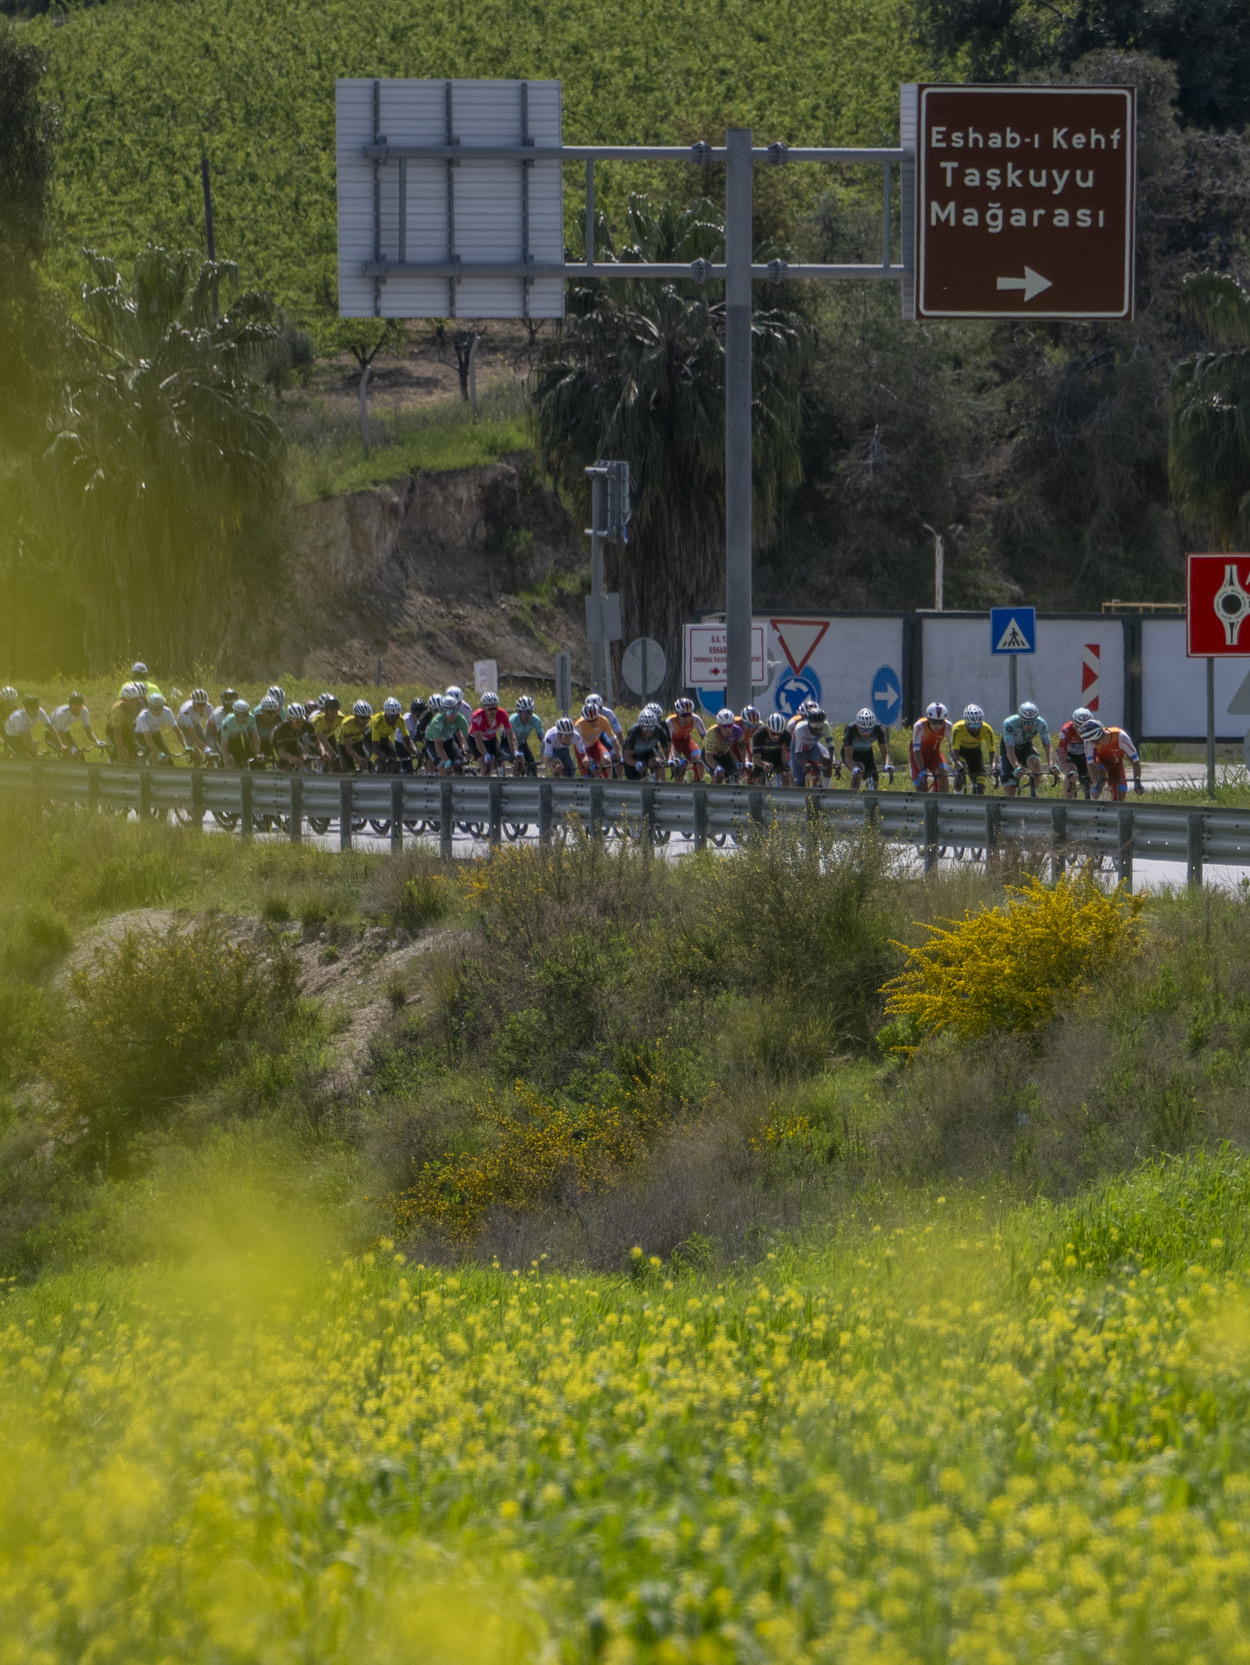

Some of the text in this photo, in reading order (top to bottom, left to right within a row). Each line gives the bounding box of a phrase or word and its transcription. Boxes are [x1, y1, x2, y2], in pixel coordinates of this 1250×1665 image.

[931, 126, 1121, 150] Eshab-ı Kehf
[940, 161, 1094, 195] Taşkuyu
[930, 201, 1104, 233] Mağarası
